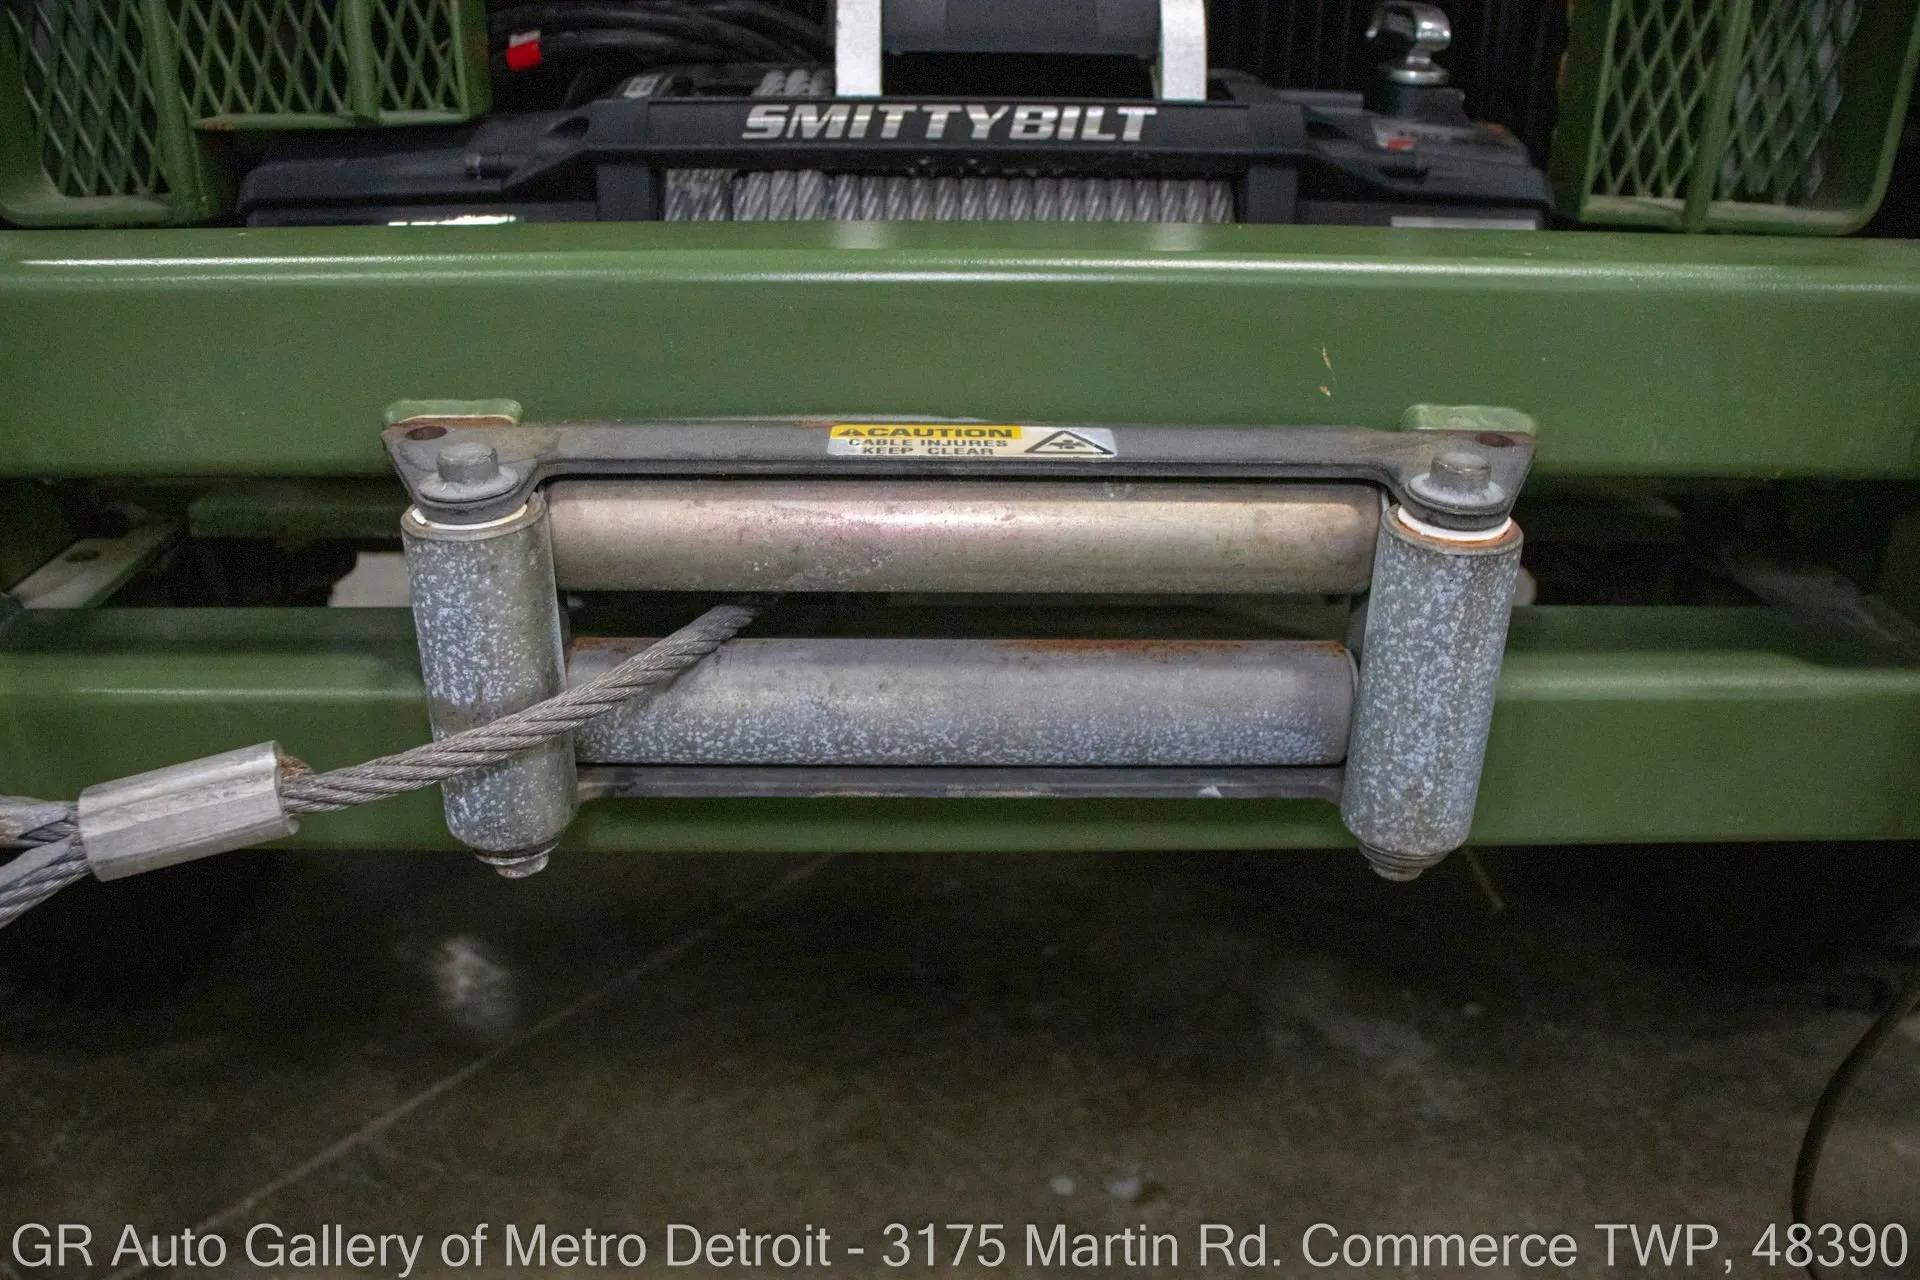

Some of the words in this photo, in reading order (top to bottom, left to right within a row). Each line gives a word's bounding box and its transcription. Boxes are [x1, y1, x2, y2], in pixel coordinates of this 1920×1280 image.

[741, 104, 1158, 142] SMITTYBILT
[867, 427, 1013, 438] CAUTION
[849, 438, 913, 447] CABLE
[920, 439, 1008, 448] INJURES
[862, 447, 914, 455] KEEP
[928, 447, 994, 456] CLEAR
